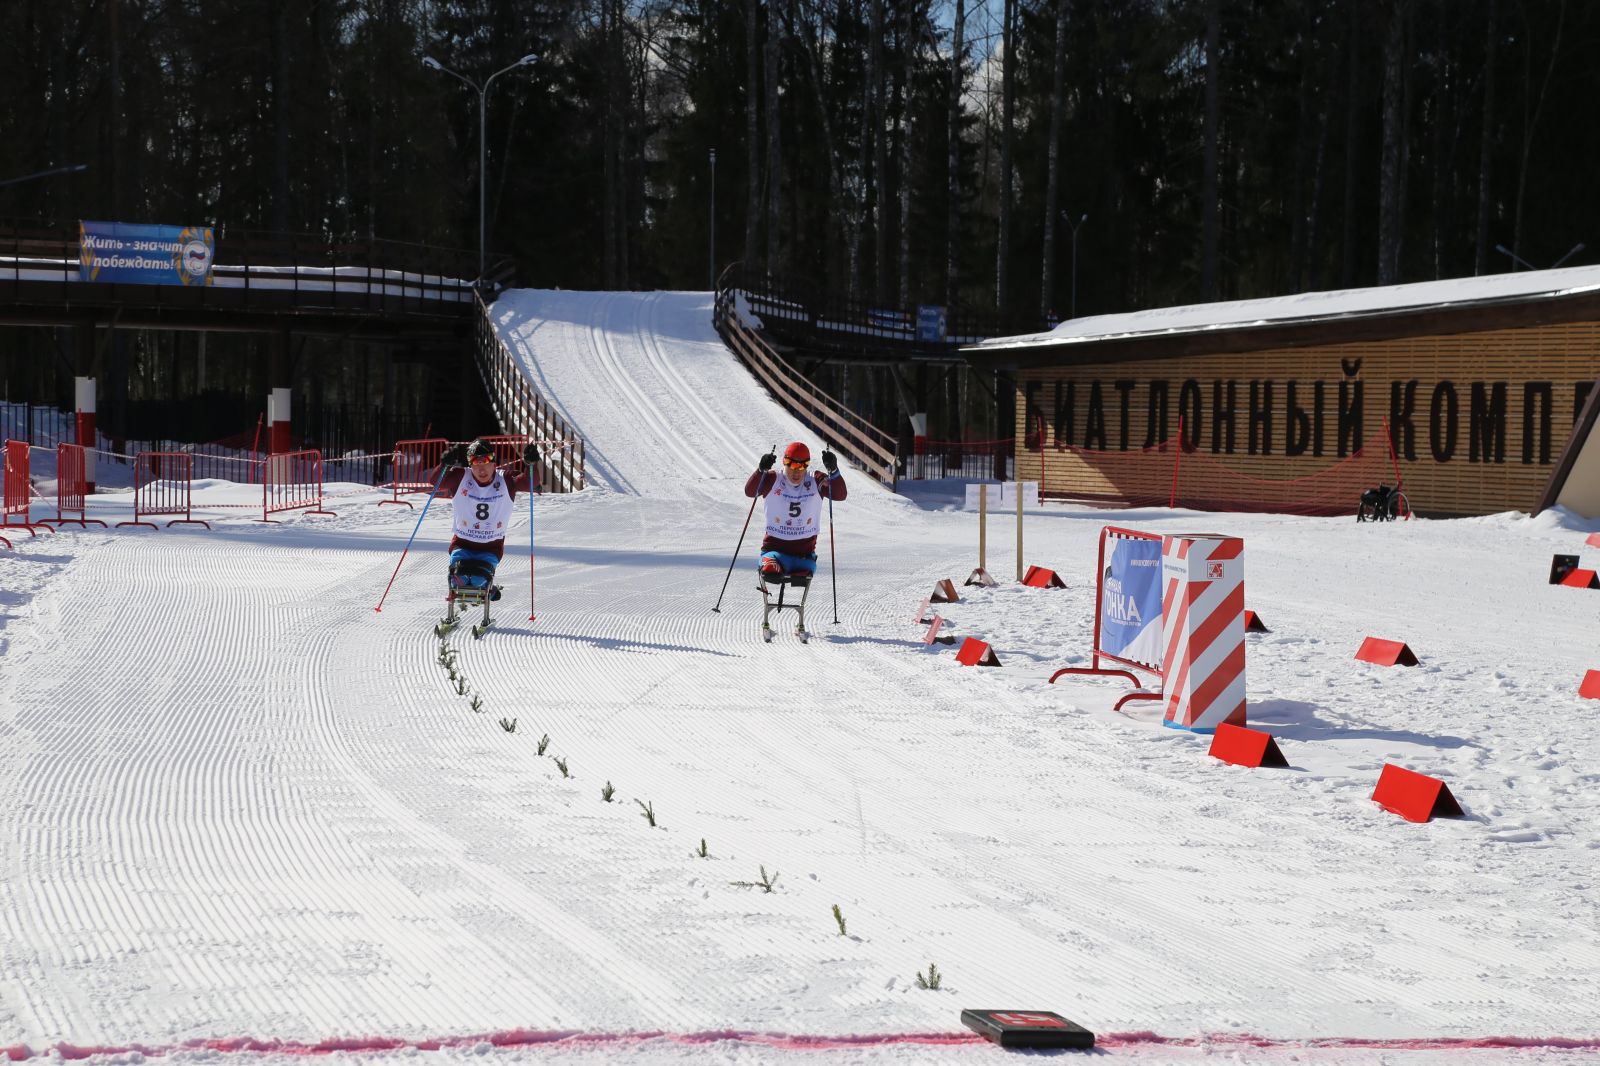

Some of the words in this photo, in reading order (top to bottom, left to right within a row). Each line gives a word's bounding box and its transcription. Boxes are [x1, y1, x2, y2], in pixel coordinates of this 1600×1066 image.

[82, 235, 123, 249] Жить
[133, 240, 184, 252] значит
[93, 255, 175, 270] побеждать!
[1025, 358, 1365, 458] БИАТЛОННЫЙ
[476, 503, 489, 520] 8
[789, 502, 801, 517] 5
[1104, 589, 1141, 622] ГОНКА
